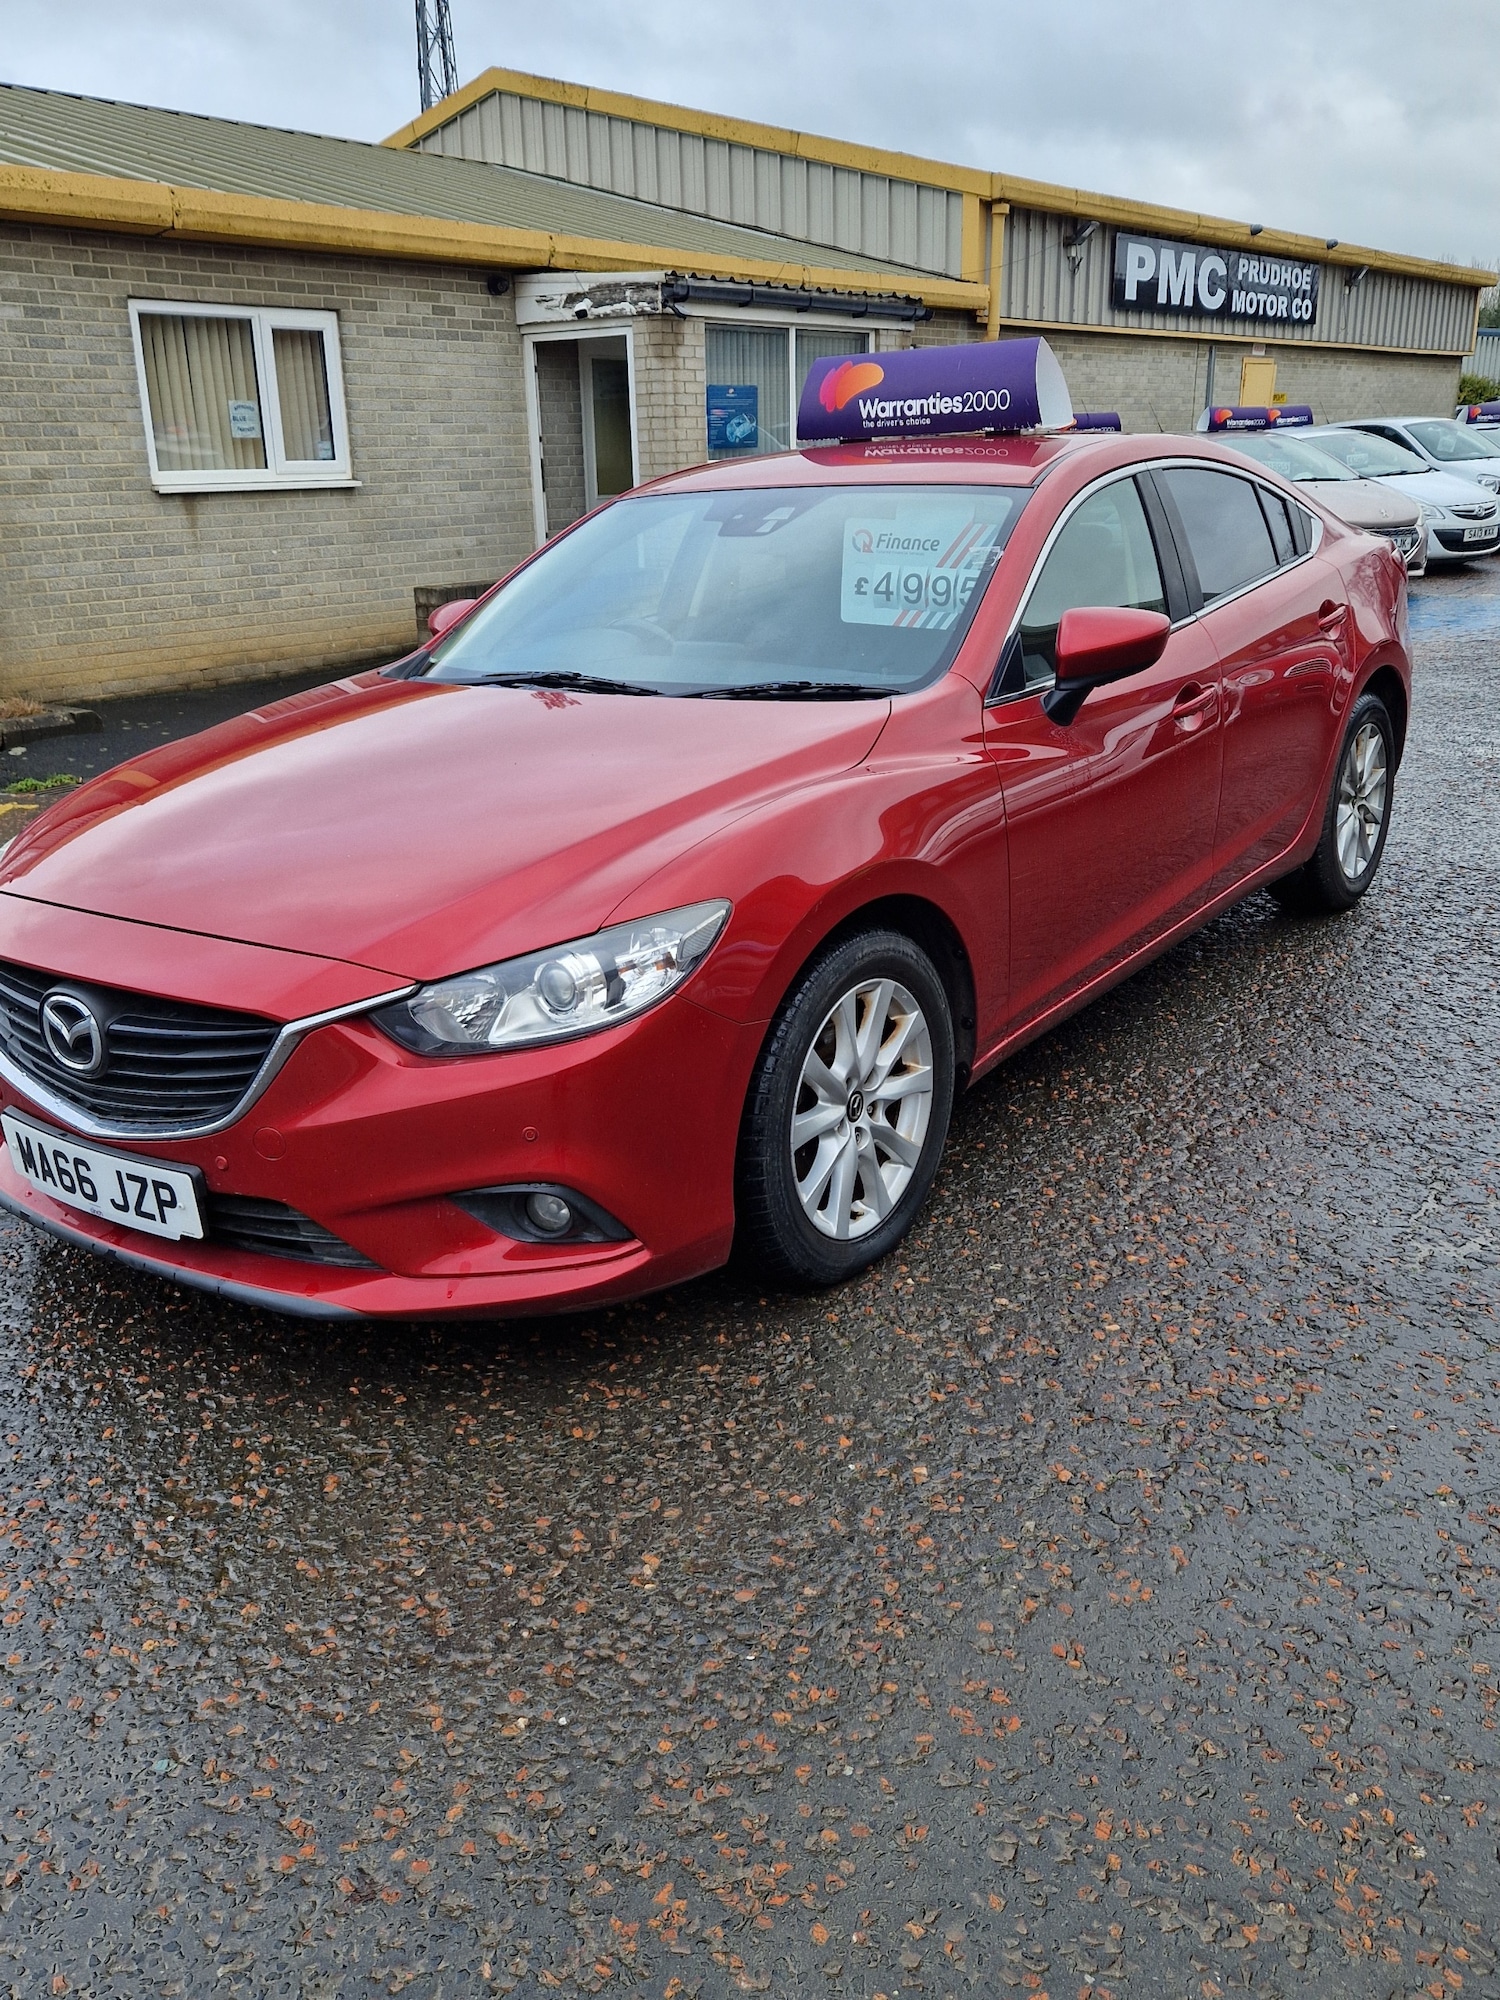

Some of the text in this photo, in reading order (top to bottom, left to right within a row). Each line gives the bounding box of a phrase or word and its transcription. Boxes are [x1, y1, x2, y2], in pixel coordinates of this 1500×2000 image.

[1124, 242, 1228, 310] PMC
[1237, 258, 1312, 291] PRUDHOE
[1231, 289, 1313, 320] MOTOR CO
[858, 388, 1011, 419] Warranties2000
[862, 416, 931, 429] the driver's choice
[876, 532, 940, 551] Finance
[15, 1131, 178, 1224] MA66 JZP
